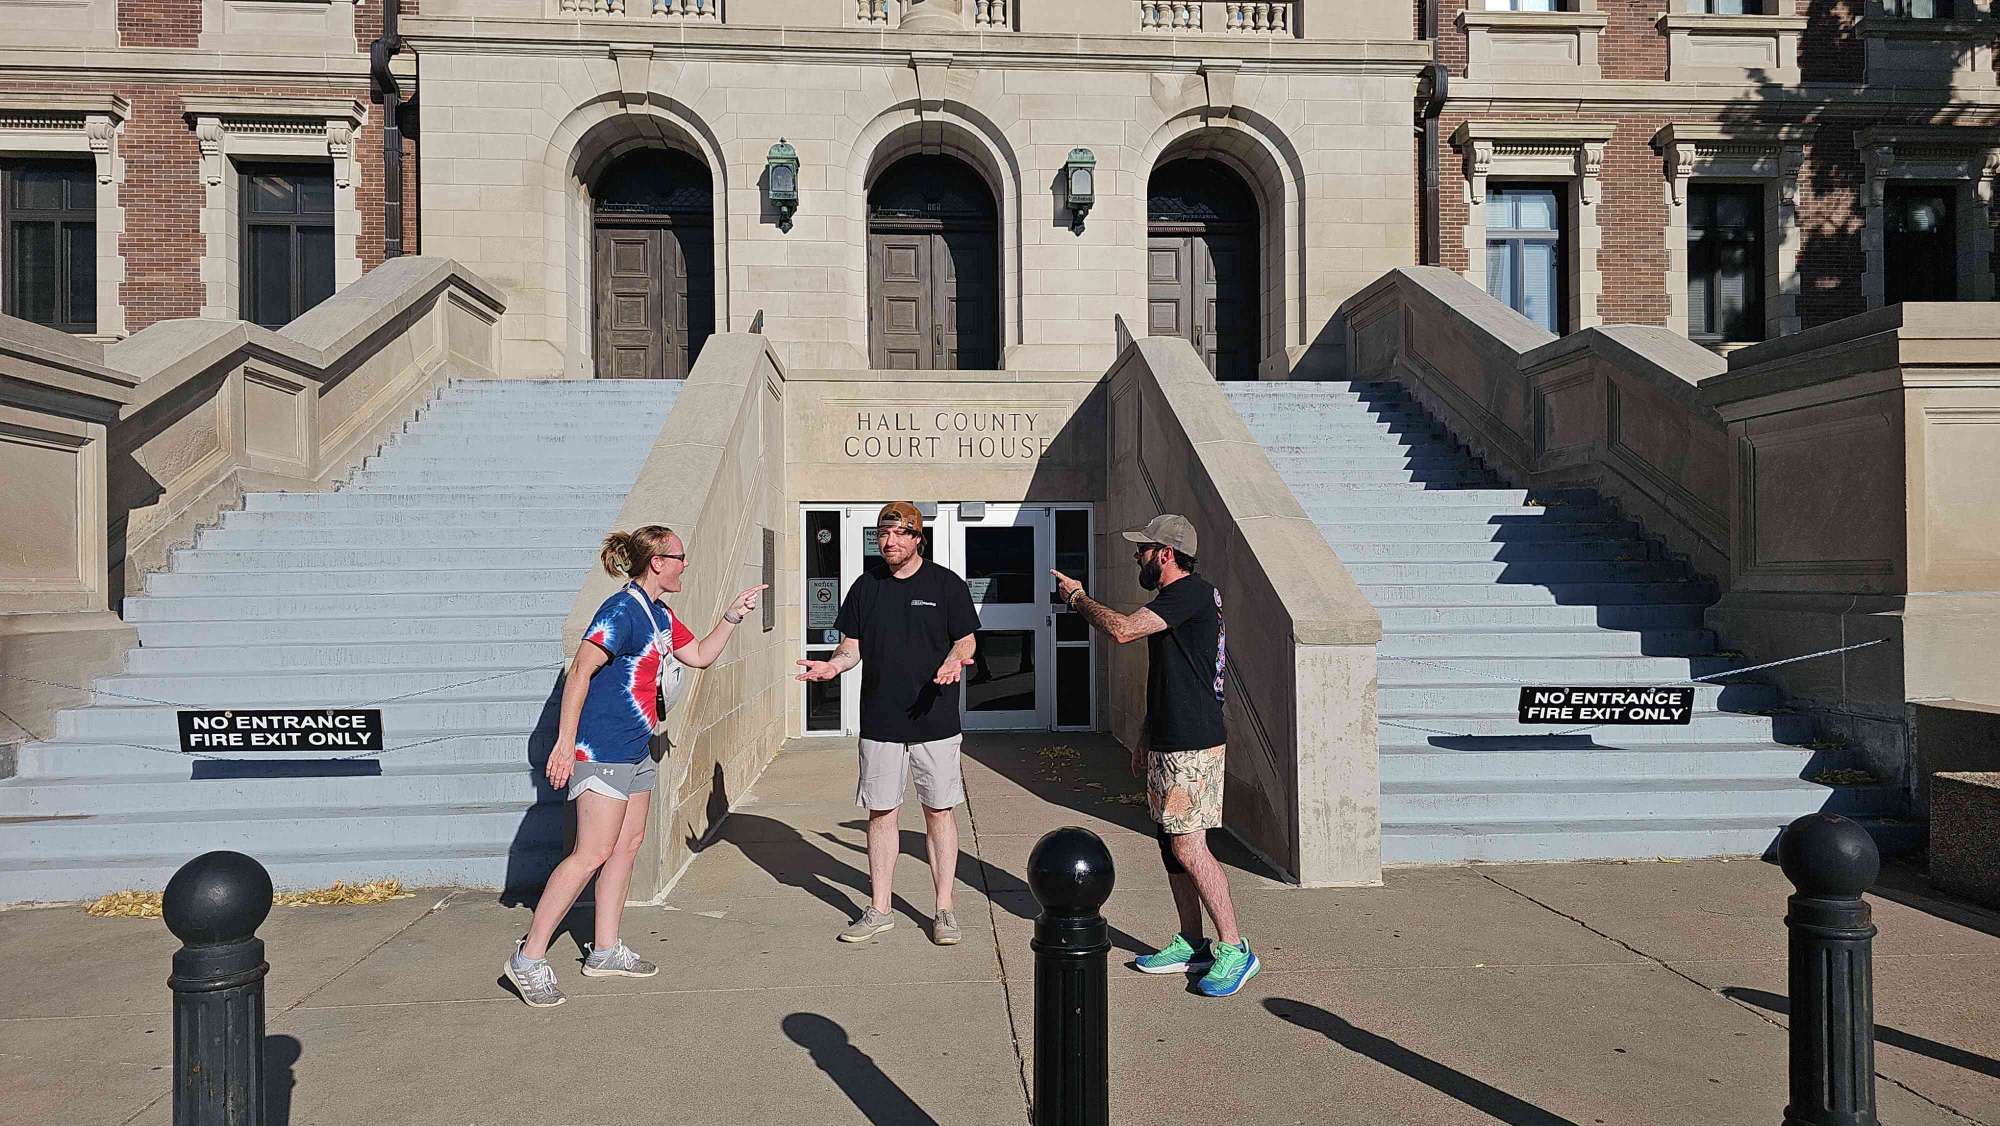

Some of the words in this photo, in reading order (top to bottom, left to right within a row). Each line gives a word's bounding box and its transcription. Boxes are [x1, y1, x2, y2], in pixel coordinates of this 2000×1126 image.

[857, 413, 921, 431] HALL
[935, 412, 1040, 432] COUNTY
[844, 436, 941, 458] COURT
[958, 436, 1051, 459] HOUSE
[1534, 692, 1566, 704] NO
[1570, 692, 1682, 705] ENTRANCE
[193, 716, 229, 730] NO
[236, 714, 367, 730] ENTRANCE
[1527, 707, 1573, 720] FIRE
[1579, 707, 1625, 720] EXIT
[1628, 707, 1684, 721] ONLY
[189, 733, 244, 747] FIRE
[250, 732, 302, 747] EXIT
[308, 731, 373, 746] ONLY
